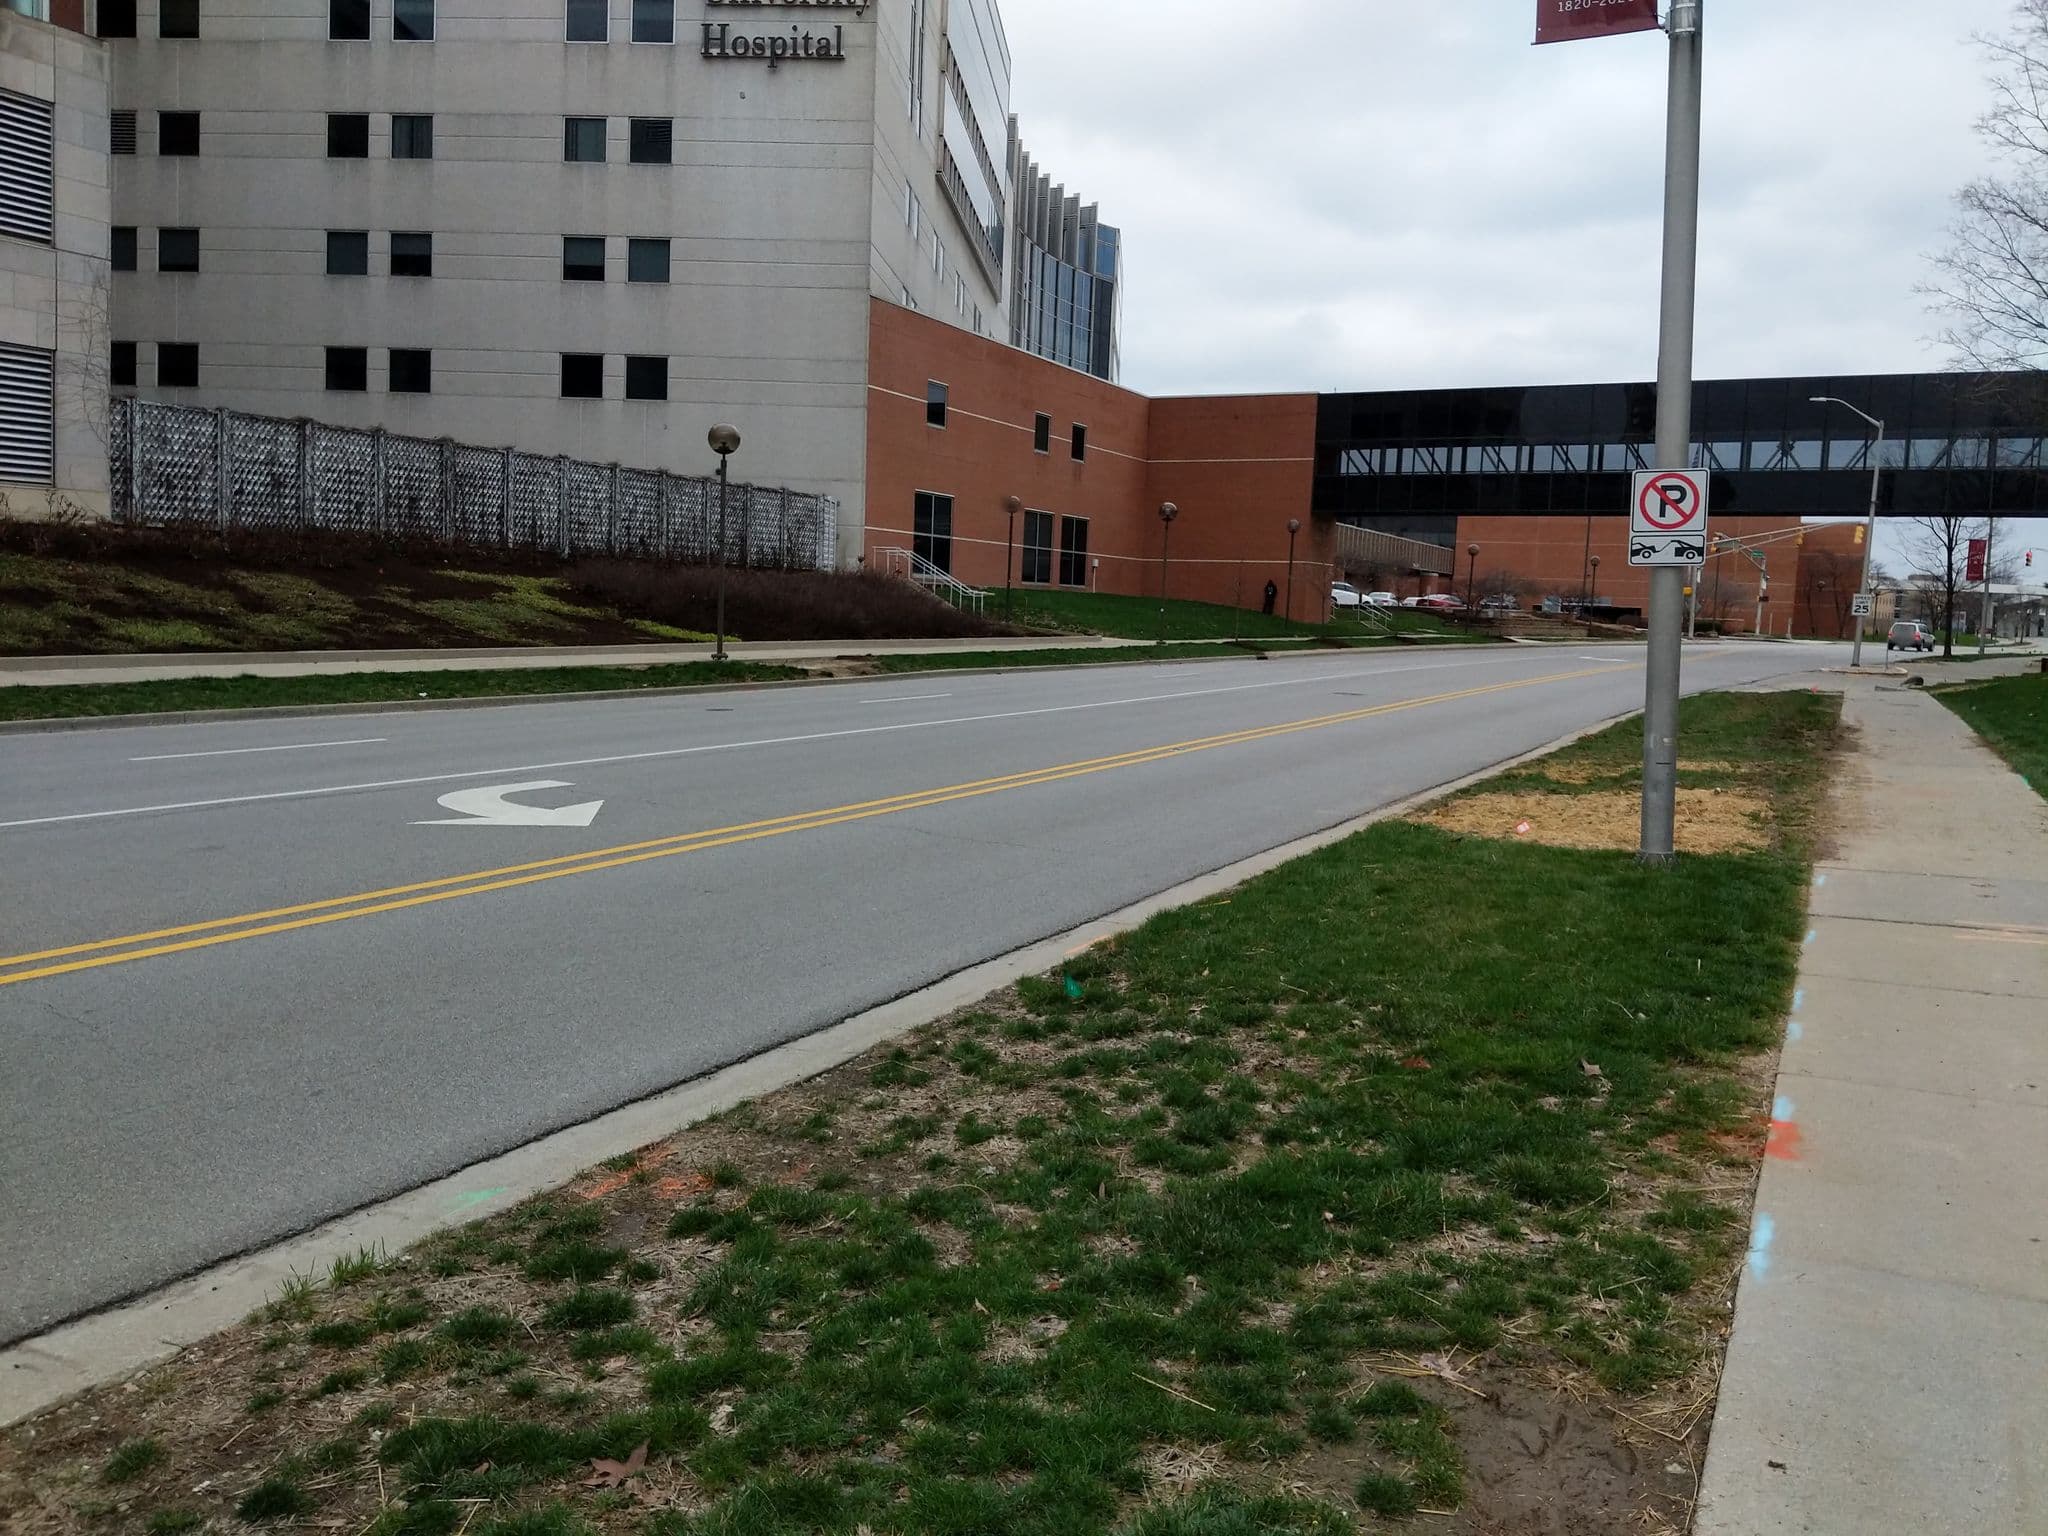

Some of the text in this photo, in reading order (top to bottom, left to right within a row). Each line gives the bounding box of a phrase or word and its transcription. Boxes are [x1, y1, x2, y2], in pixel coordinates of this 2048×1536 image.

[1558, 0, 1634, 12] 1820-2
[701, 23, 845, 68] Hospital
[1659, 485, 1687, 518] P
[1854, 605, 1869, 613] 25
